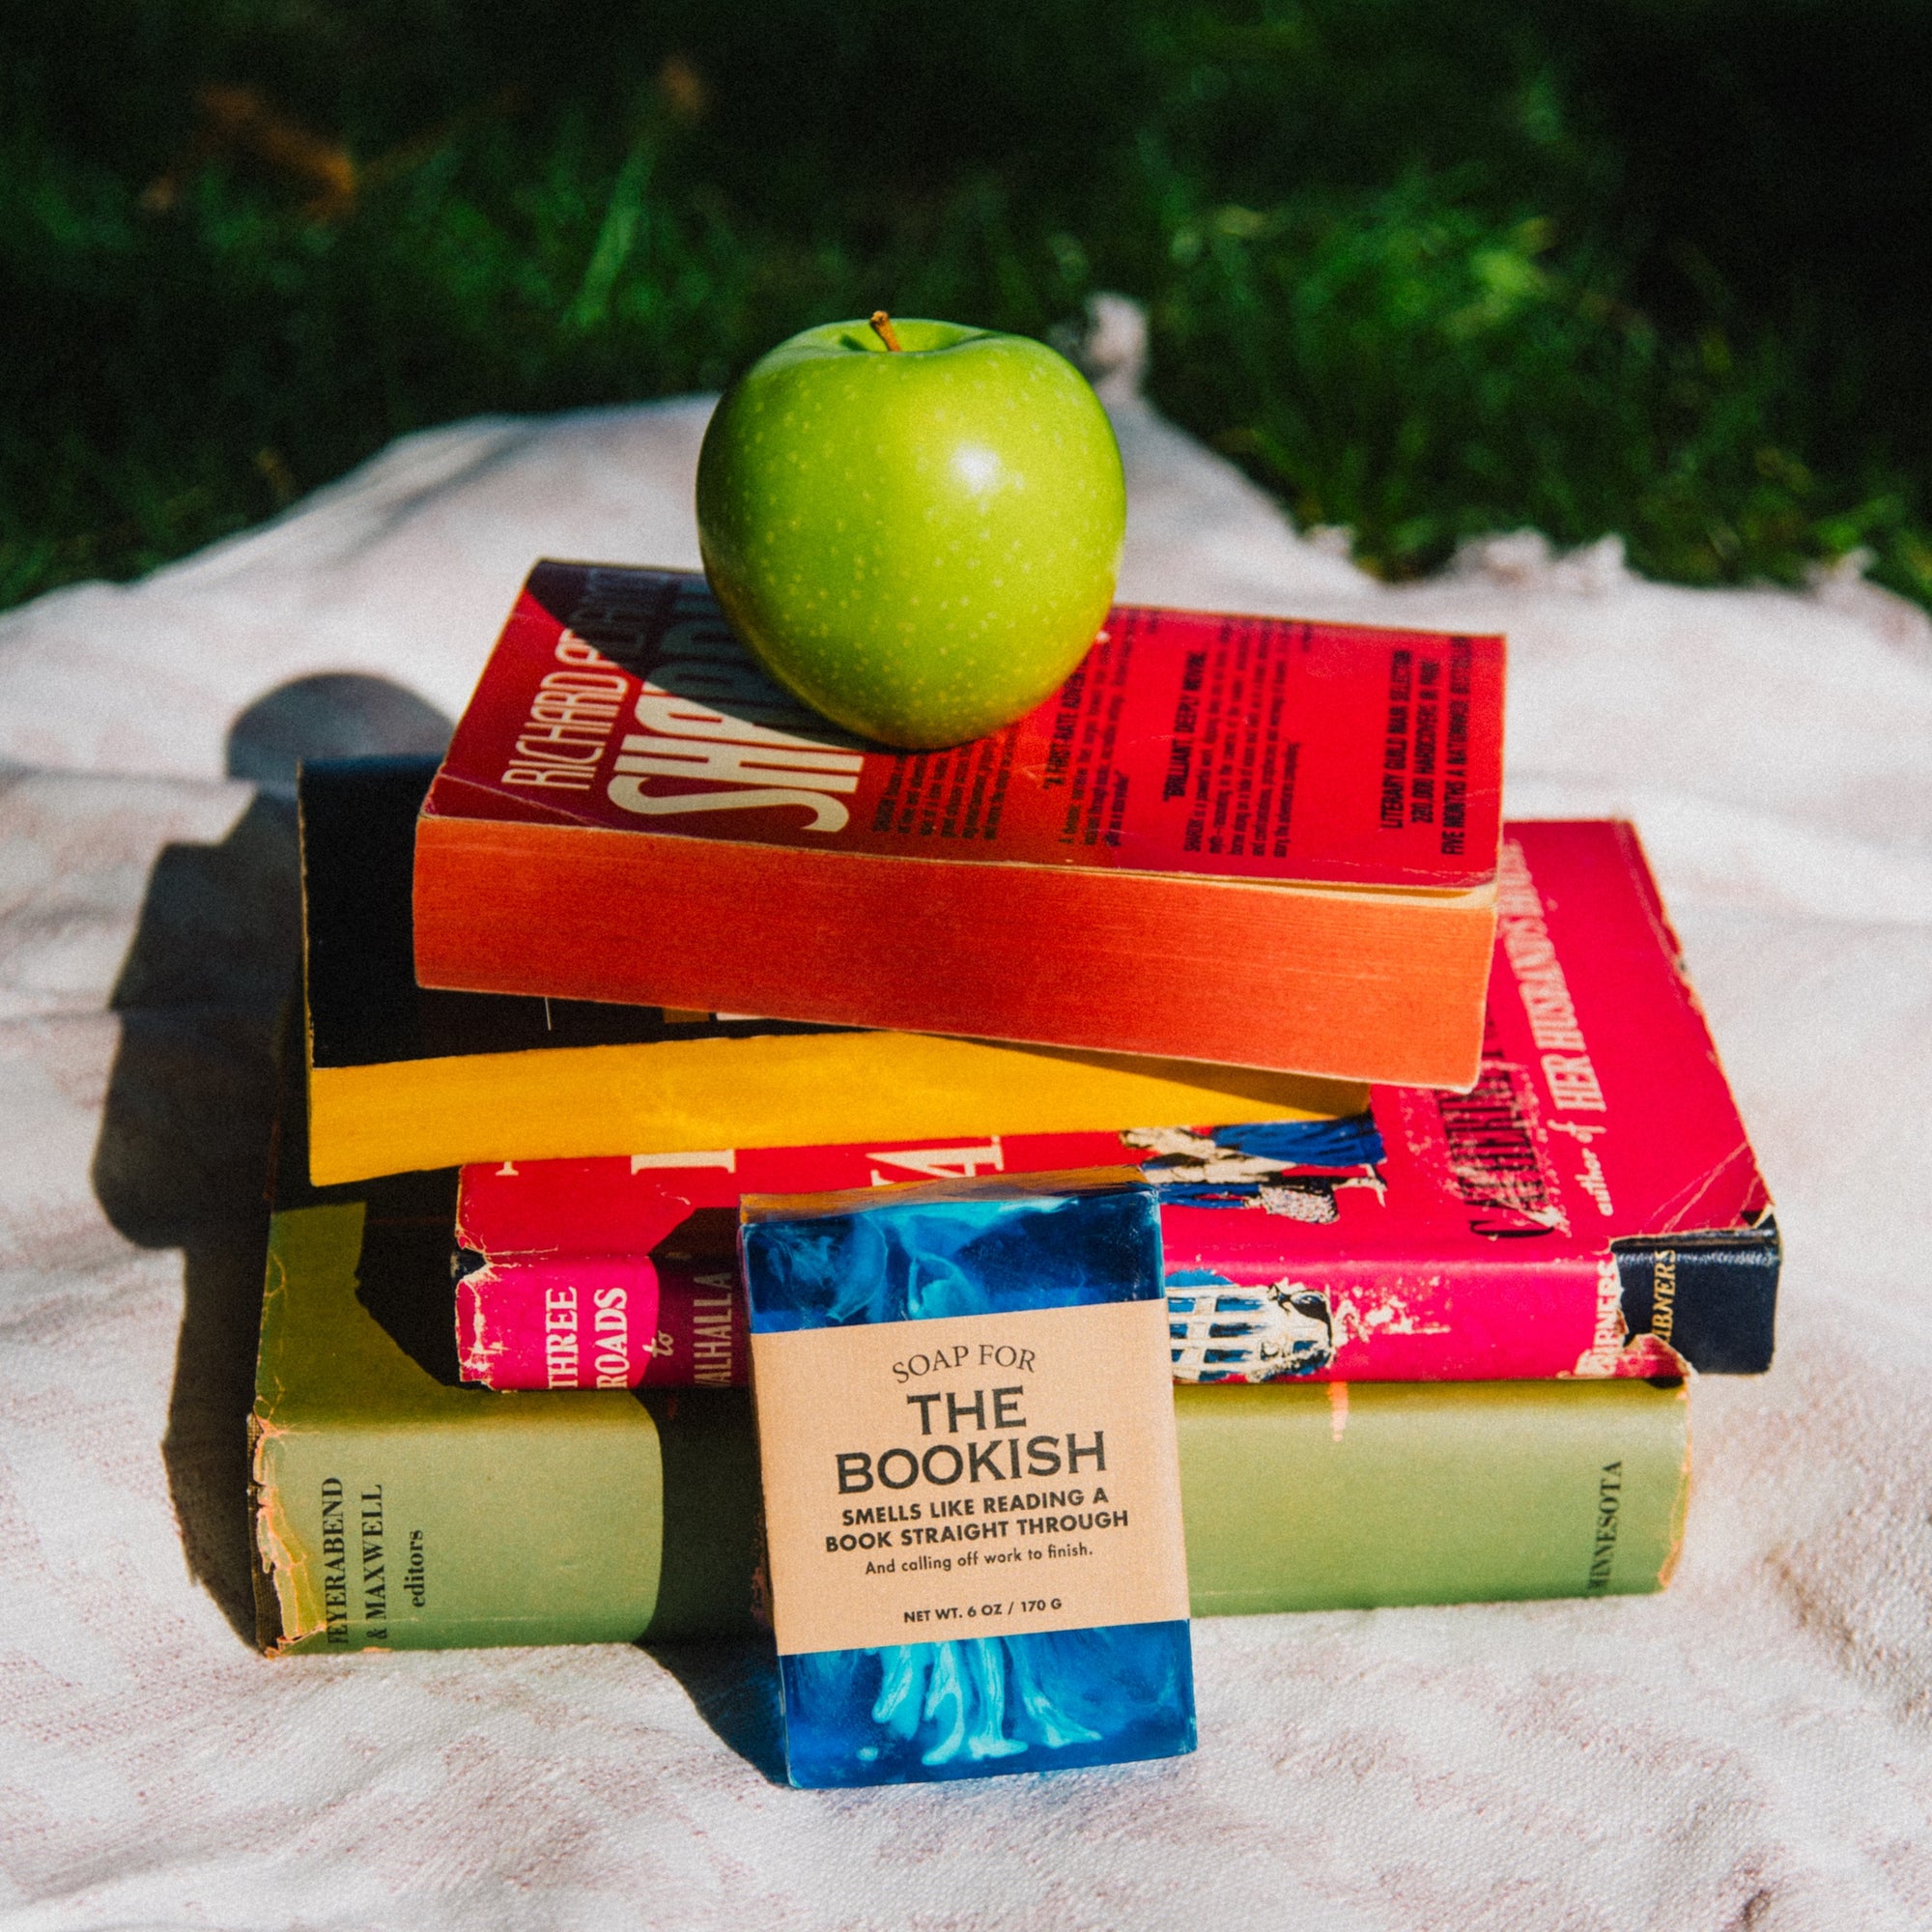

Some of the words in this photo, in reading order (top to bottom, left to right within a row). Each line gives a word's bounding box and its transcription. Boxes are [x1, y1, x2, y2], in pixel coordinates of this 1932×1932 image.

[501, 670, 629, 791] RICHARD
[1385, 736, 1406, 770] GUILD
[1446, 768, 1465, 777] A
[1379, 772, 1406, 829] LITERARY
[1443, 779, 1465, 828] MONTHS
[1442, 830, 1463, 855] FIVE
[1541, 1054, 1607, 1113] HER
[1547, 1119, 1607, 1143] of
[1574, 1148, 1613, 1216] author
[1651, 1249, 1676, 1344] IBNERS
[545, 1286, 579, 1389] THREE
[594, 1287, 629, 1389] ROADS
[642, 1330, 675, 1359] to
[892, 1345, 969, 1383] SOAP
[979, 1344, 1036, 1374] FOR
[906, 1385, 1027, 1435] THE
[836, 1430, 1107, 1494] BOOKISH
[825, 1531, 893, 1552] BOOK
[900, 1520, 1009, 1547] STRAIGHT
[1016, 1510, 1128, 1535] THROUGH
[842, 1503, 922, 1526] SMELLS
[929, 1498, 976, 1519] LIKE
[983, 1489, 1084, 1514] READING
[1093, 1487, 1109, 1504] A
[322, 1477, 349, 1644] FEYERABEND
[361, 1484, 386, 1620] MAXWELL
[404, 1529, 425, 1608] editors
[866, 1559, 895, 1575] And
[901, 1555, 952, 1573] calling
[957, 1552, 979, 1567] off
[984, 1548, 1022, 1565] work
[1027, 1547, 1042, 1560] to
[1047, 1542, 1093, 1558] finish.
[366, 1629, 387, 1639] &
[903, 1609, 930, 1623] NET
[935, 1606, 963, 1621] WT.
[967, 1605, 977, 1617] 6
[981, 1603, 1003, 1616] OZ
[1008, 1602, 1013, 1615] /
[1021, 1600, 1046, 1613] 170
[1050, 1598, 1063, 1610] G
